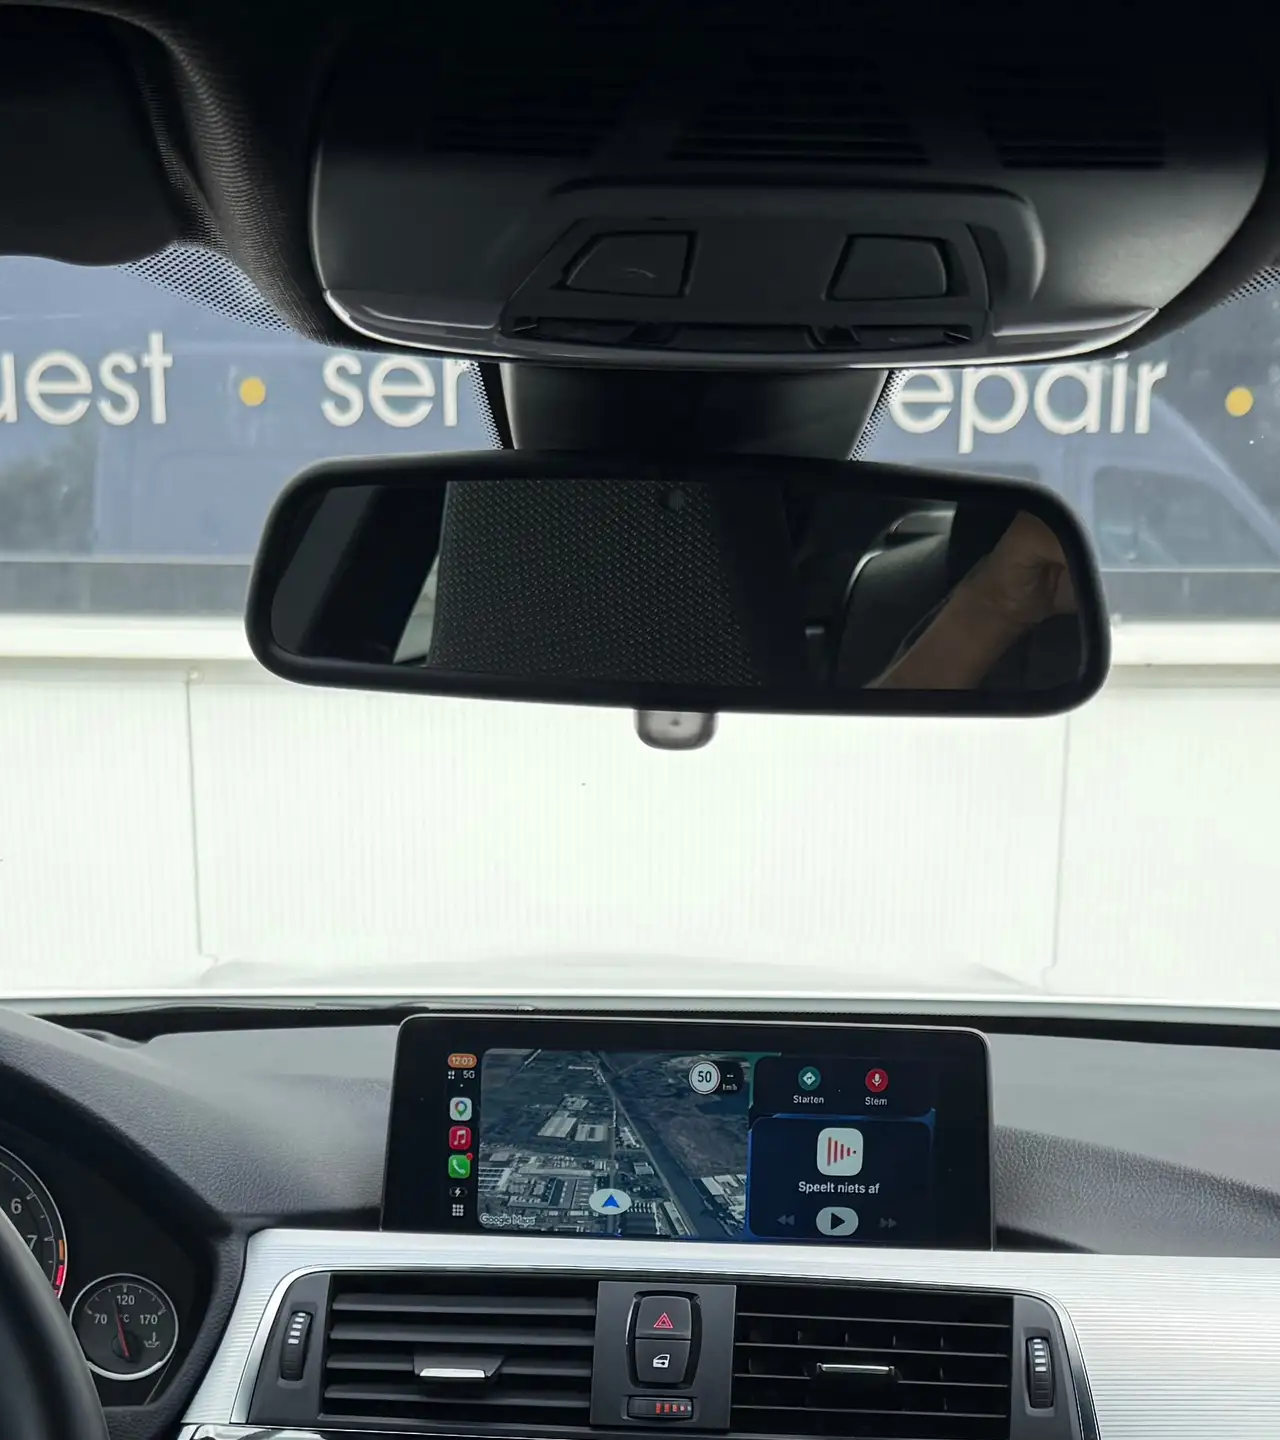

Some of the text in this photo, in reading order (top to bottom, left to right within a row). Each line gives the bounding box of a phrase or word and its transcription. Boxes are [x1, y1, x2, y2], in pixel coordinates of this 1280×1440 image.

[322, 351, 470, 430] ser
[888, 354, 1168, 453] epair
[463, 1070, 475, 1079] 5G
[697, 1071, 712, 1083] 50
[793, 1095, 824, 1104] Starten
[865, 1096, 888, 1106] Stem
[798, 1181, 881, 1194] Speelt niets af
[10, 1198, 22, 1214] 6
[480, 1213, 512, 1227] Google
[27, 1234, 38, 1251] 7
[116, 1294, 135, 1306] 120
[94, 1313, 108, 1325] 70
[139, 1313, 158, 1326] 170
